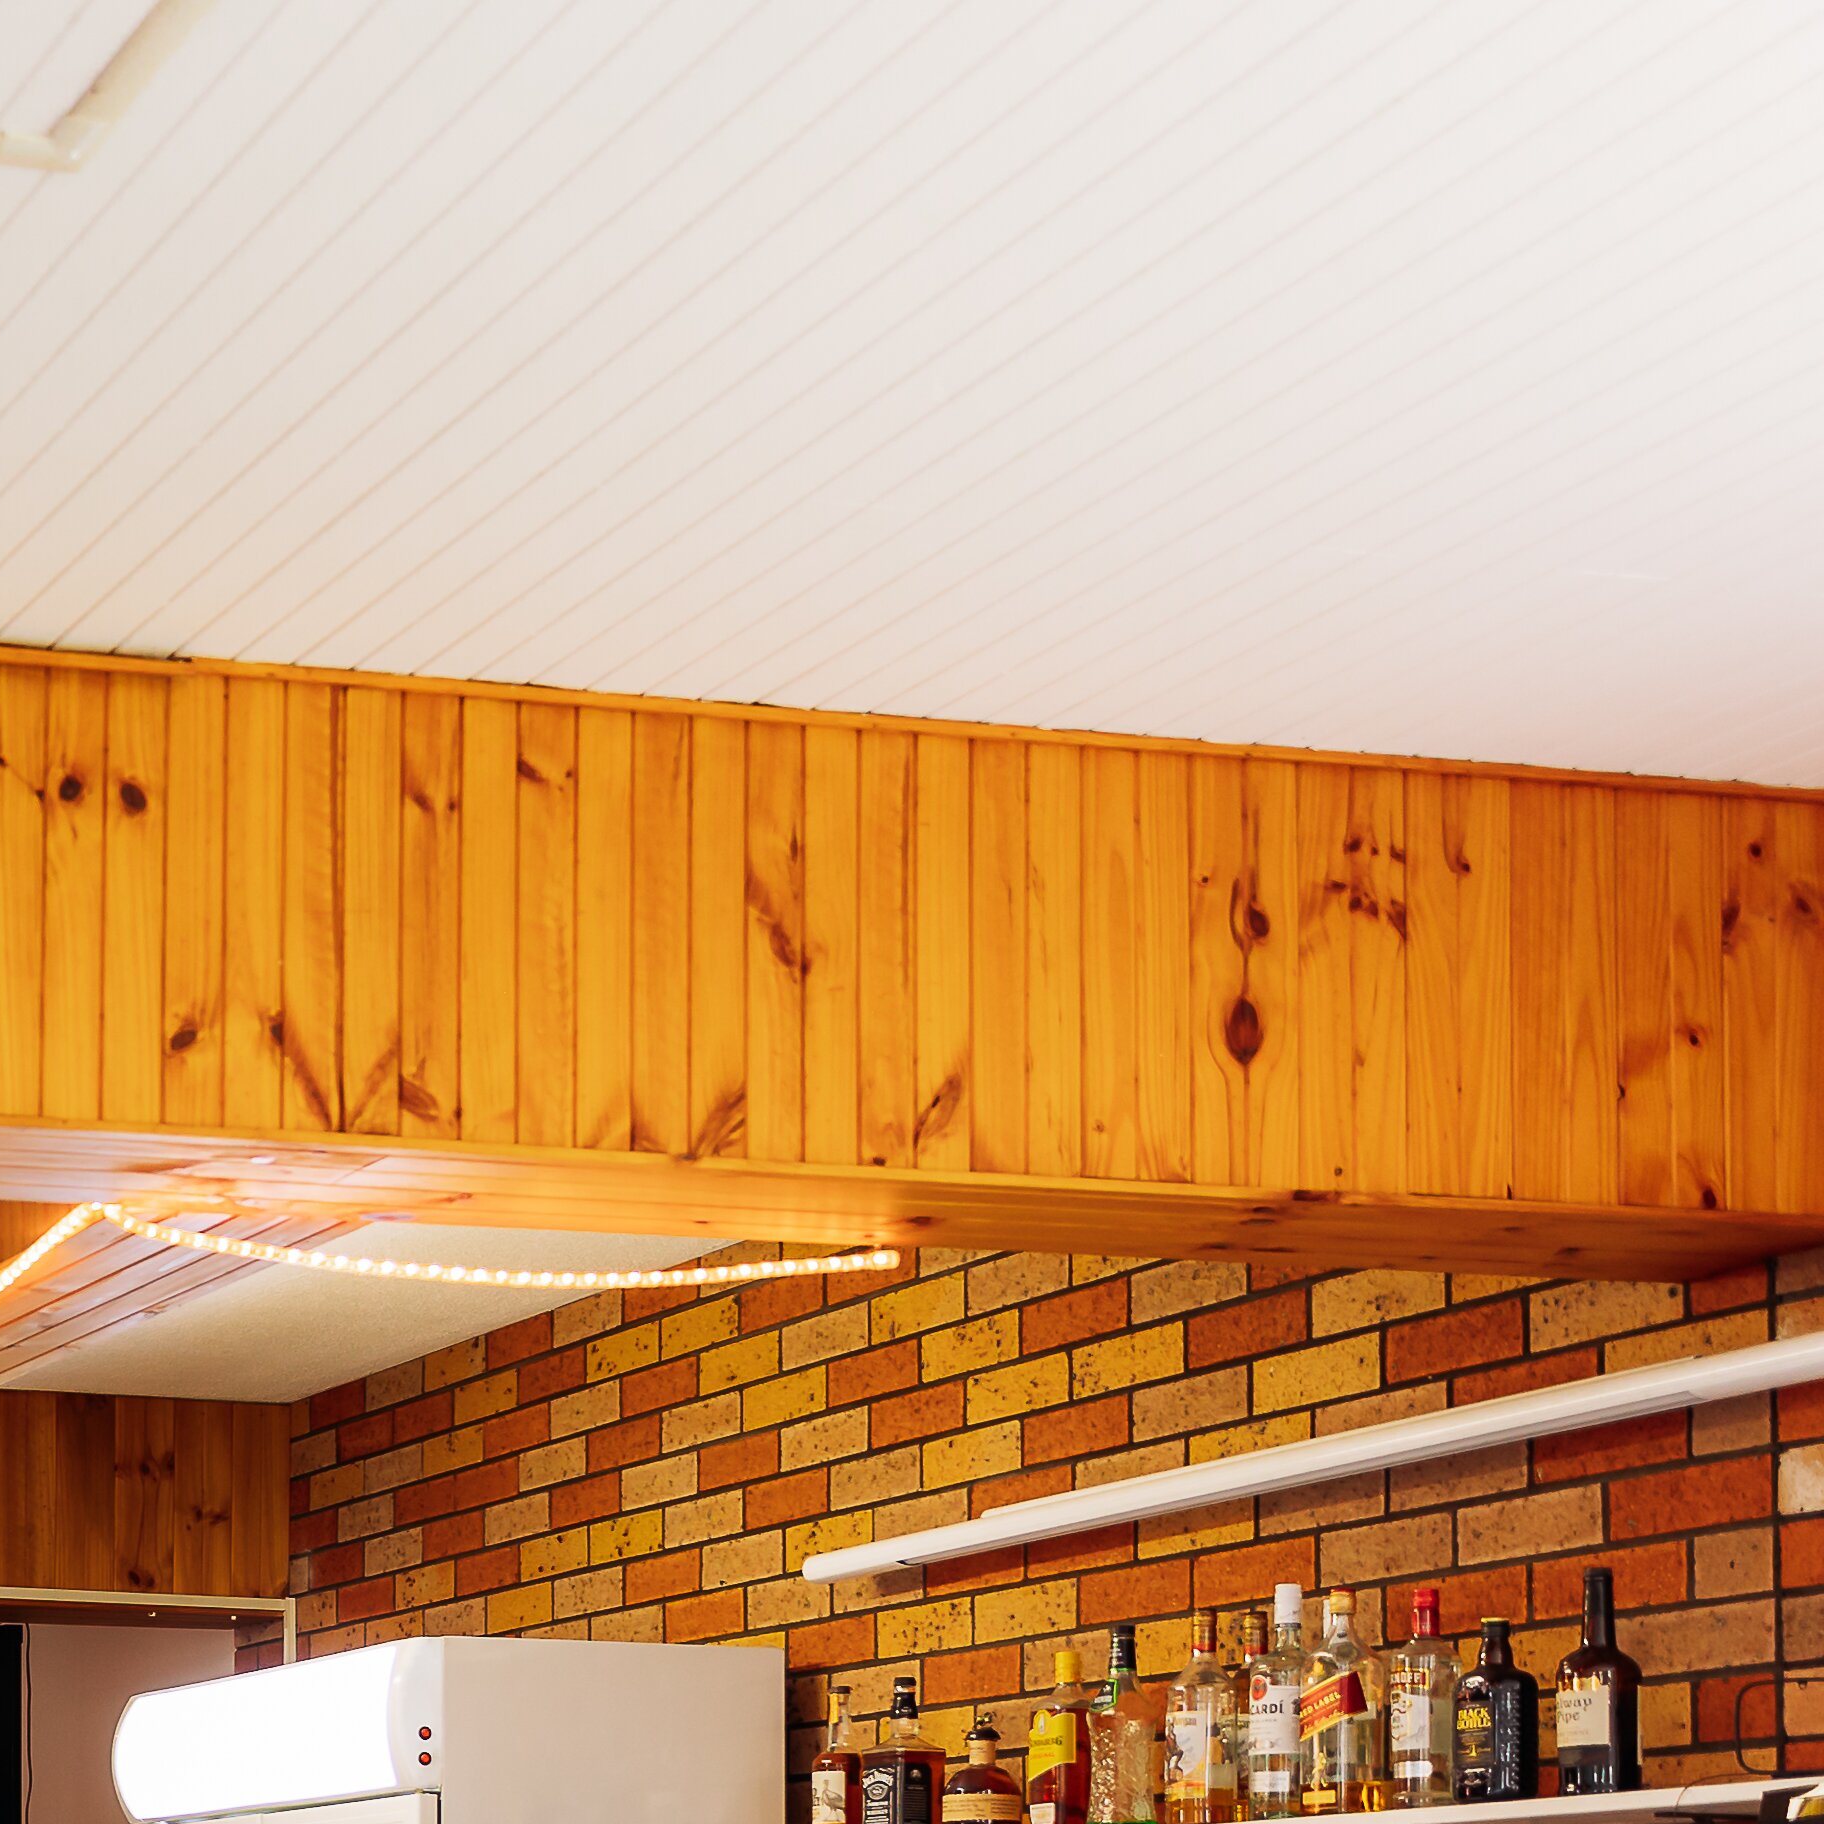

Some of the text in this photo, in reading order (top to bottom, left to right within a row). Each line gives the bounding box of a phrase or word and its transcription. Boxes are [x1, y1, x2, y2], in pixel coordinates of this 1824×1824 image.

[1250, 1699, 1284, 1715] CARDÍ
[1314, 1691, 1342, 1710] LABEL
[1457, 1707, 1491, 1720] BLACK
